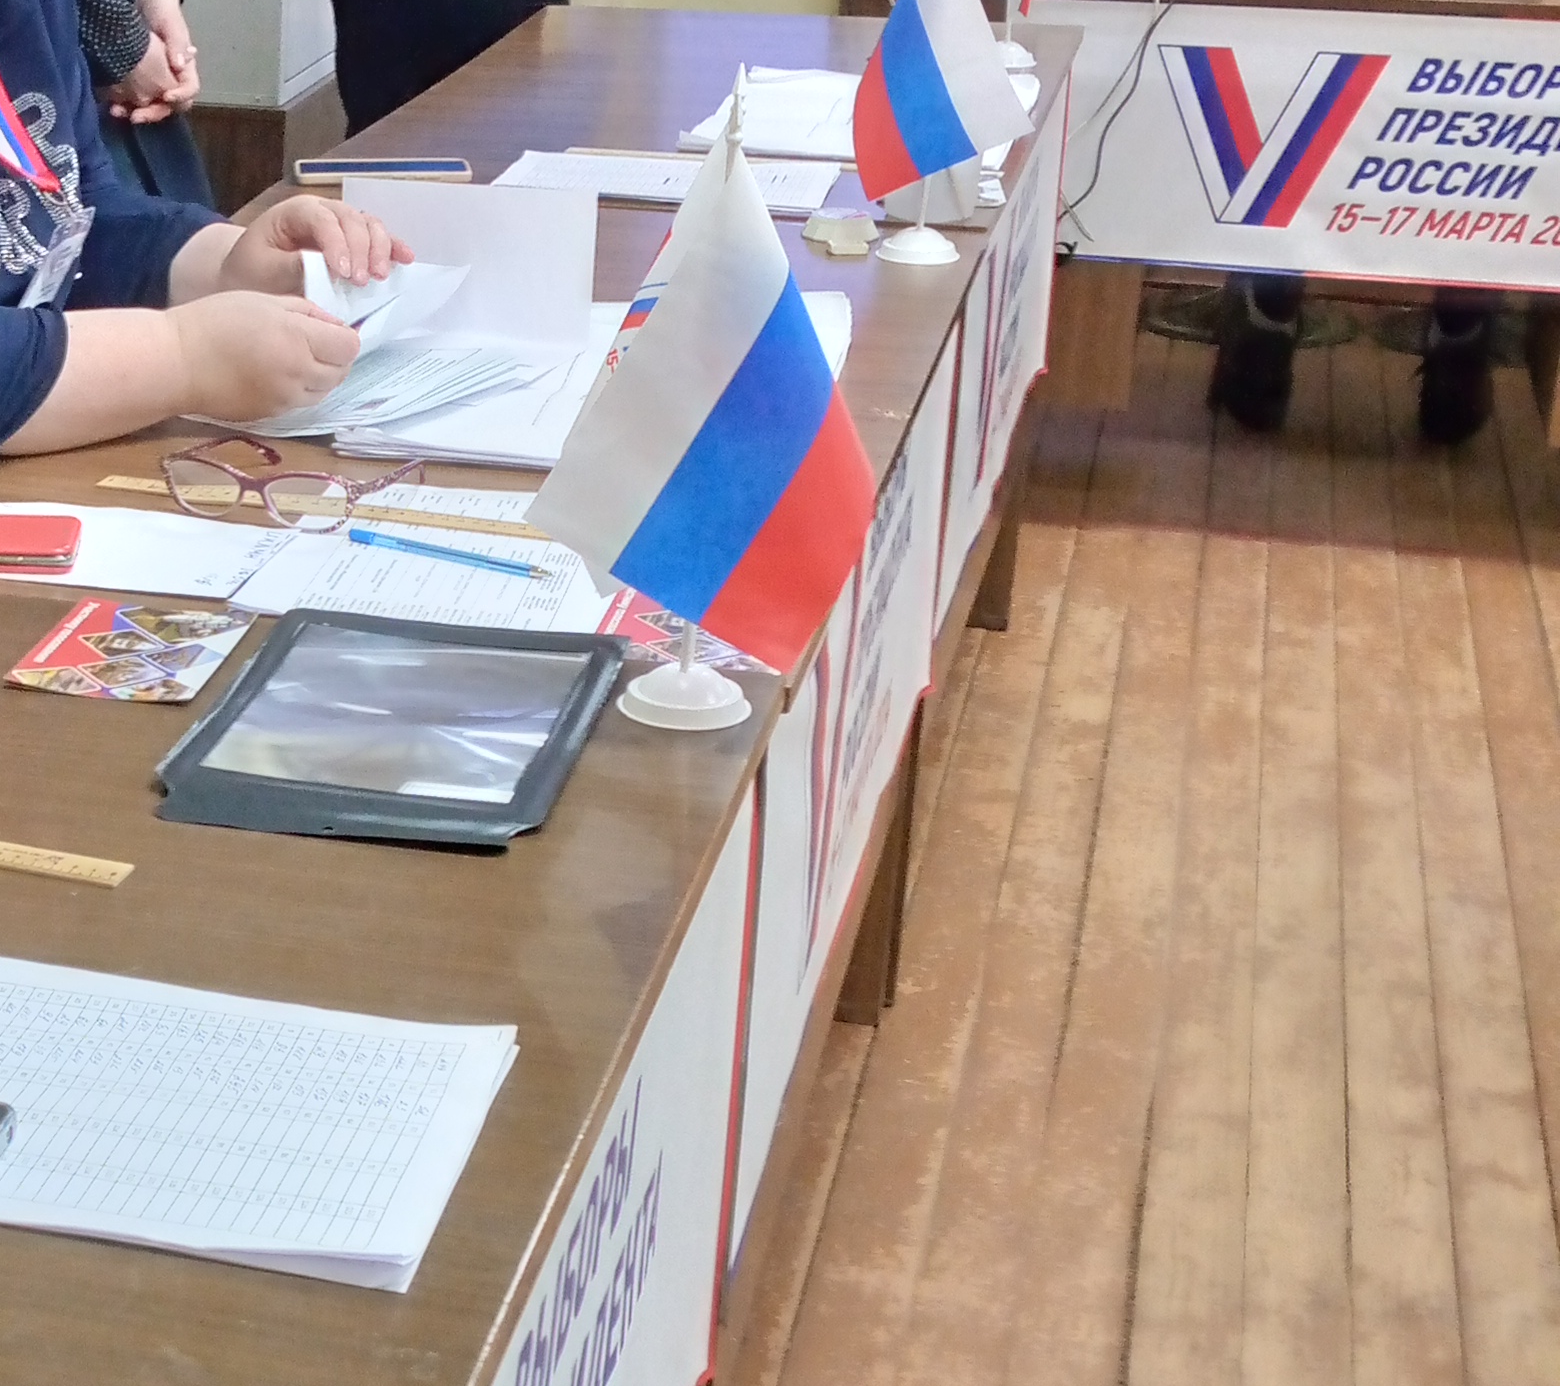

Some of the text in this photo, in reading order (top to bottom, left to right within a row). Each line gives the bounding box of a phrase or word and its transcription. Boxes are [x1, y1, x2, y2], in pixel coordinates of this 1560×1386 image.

[1376, 107, 1560, 157] ПРЕЗИД
[1346, 155, 1538, 200] РОССИИ
[1415, 208, 1530, 245] МАРТА
